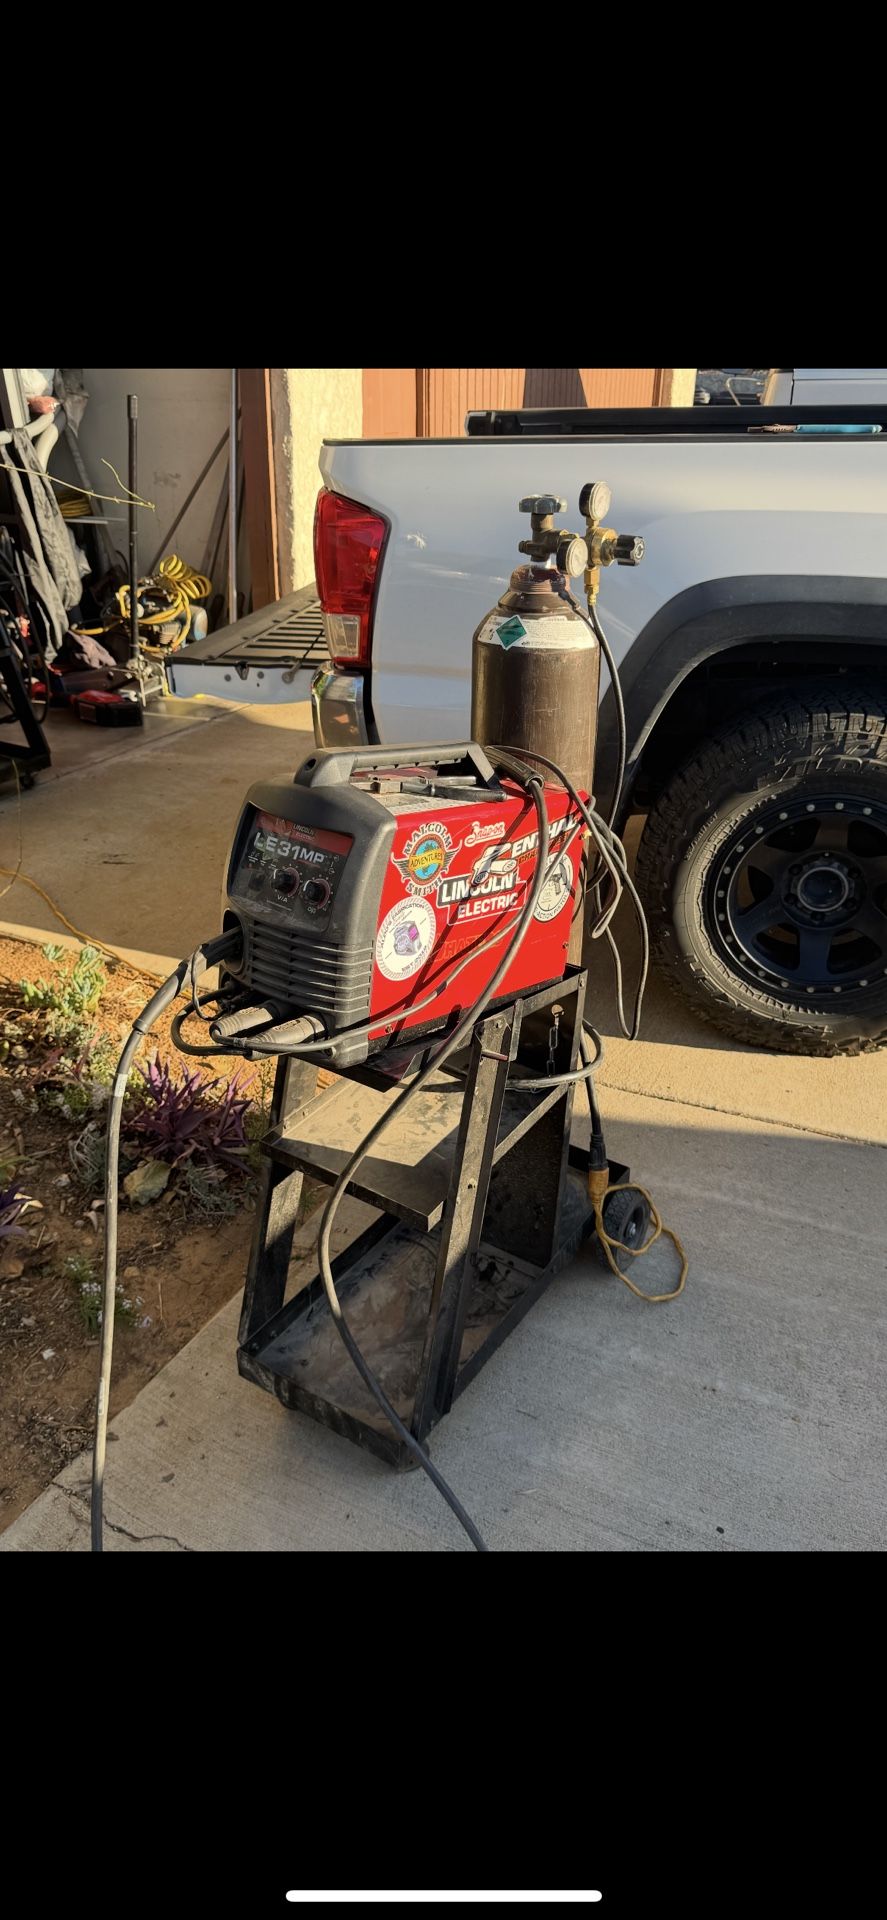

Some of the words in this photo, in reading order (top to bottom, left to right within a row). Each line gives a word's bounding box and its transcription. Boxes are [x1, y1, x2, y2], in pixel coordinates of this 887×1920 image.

[254, 832, 325, 863] LE31MP
[403, 822, 452, 856] MALCOLM
[406, 877, 444, 897] SMITH
[457, 892, 518, 919] ELECTRIC
